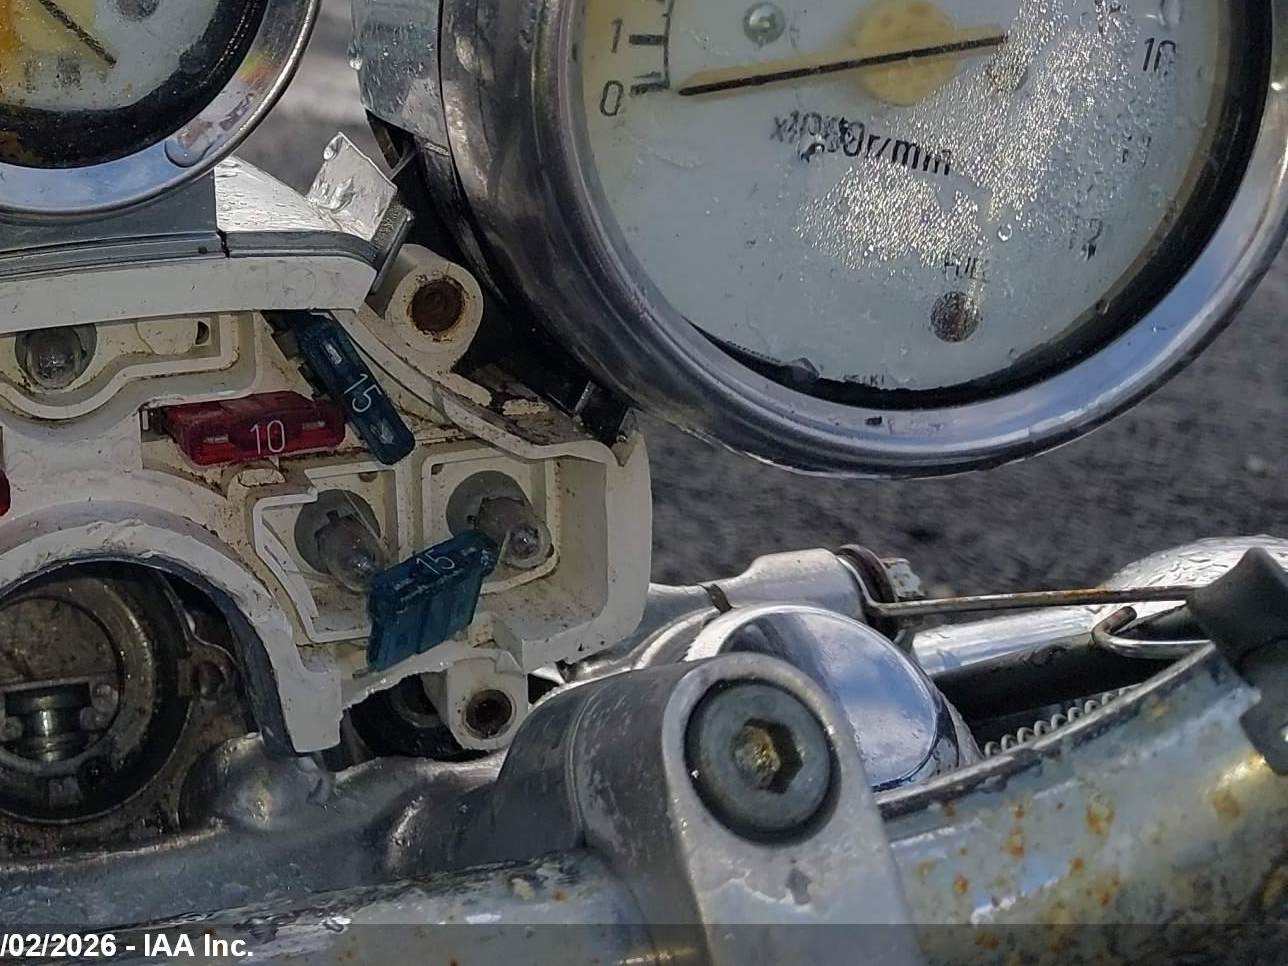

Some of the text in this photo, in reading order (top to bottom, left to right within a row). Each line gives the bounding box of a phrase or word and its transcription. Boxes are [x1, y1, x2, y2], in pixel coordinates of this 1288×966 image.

[610, 18, 622, 53] 1
[599, 80, 624, 118] 0
[343, 373, 383, 414] 15
[249, 419, 286, 455] 10
[415, 549, 456, 576] 15
